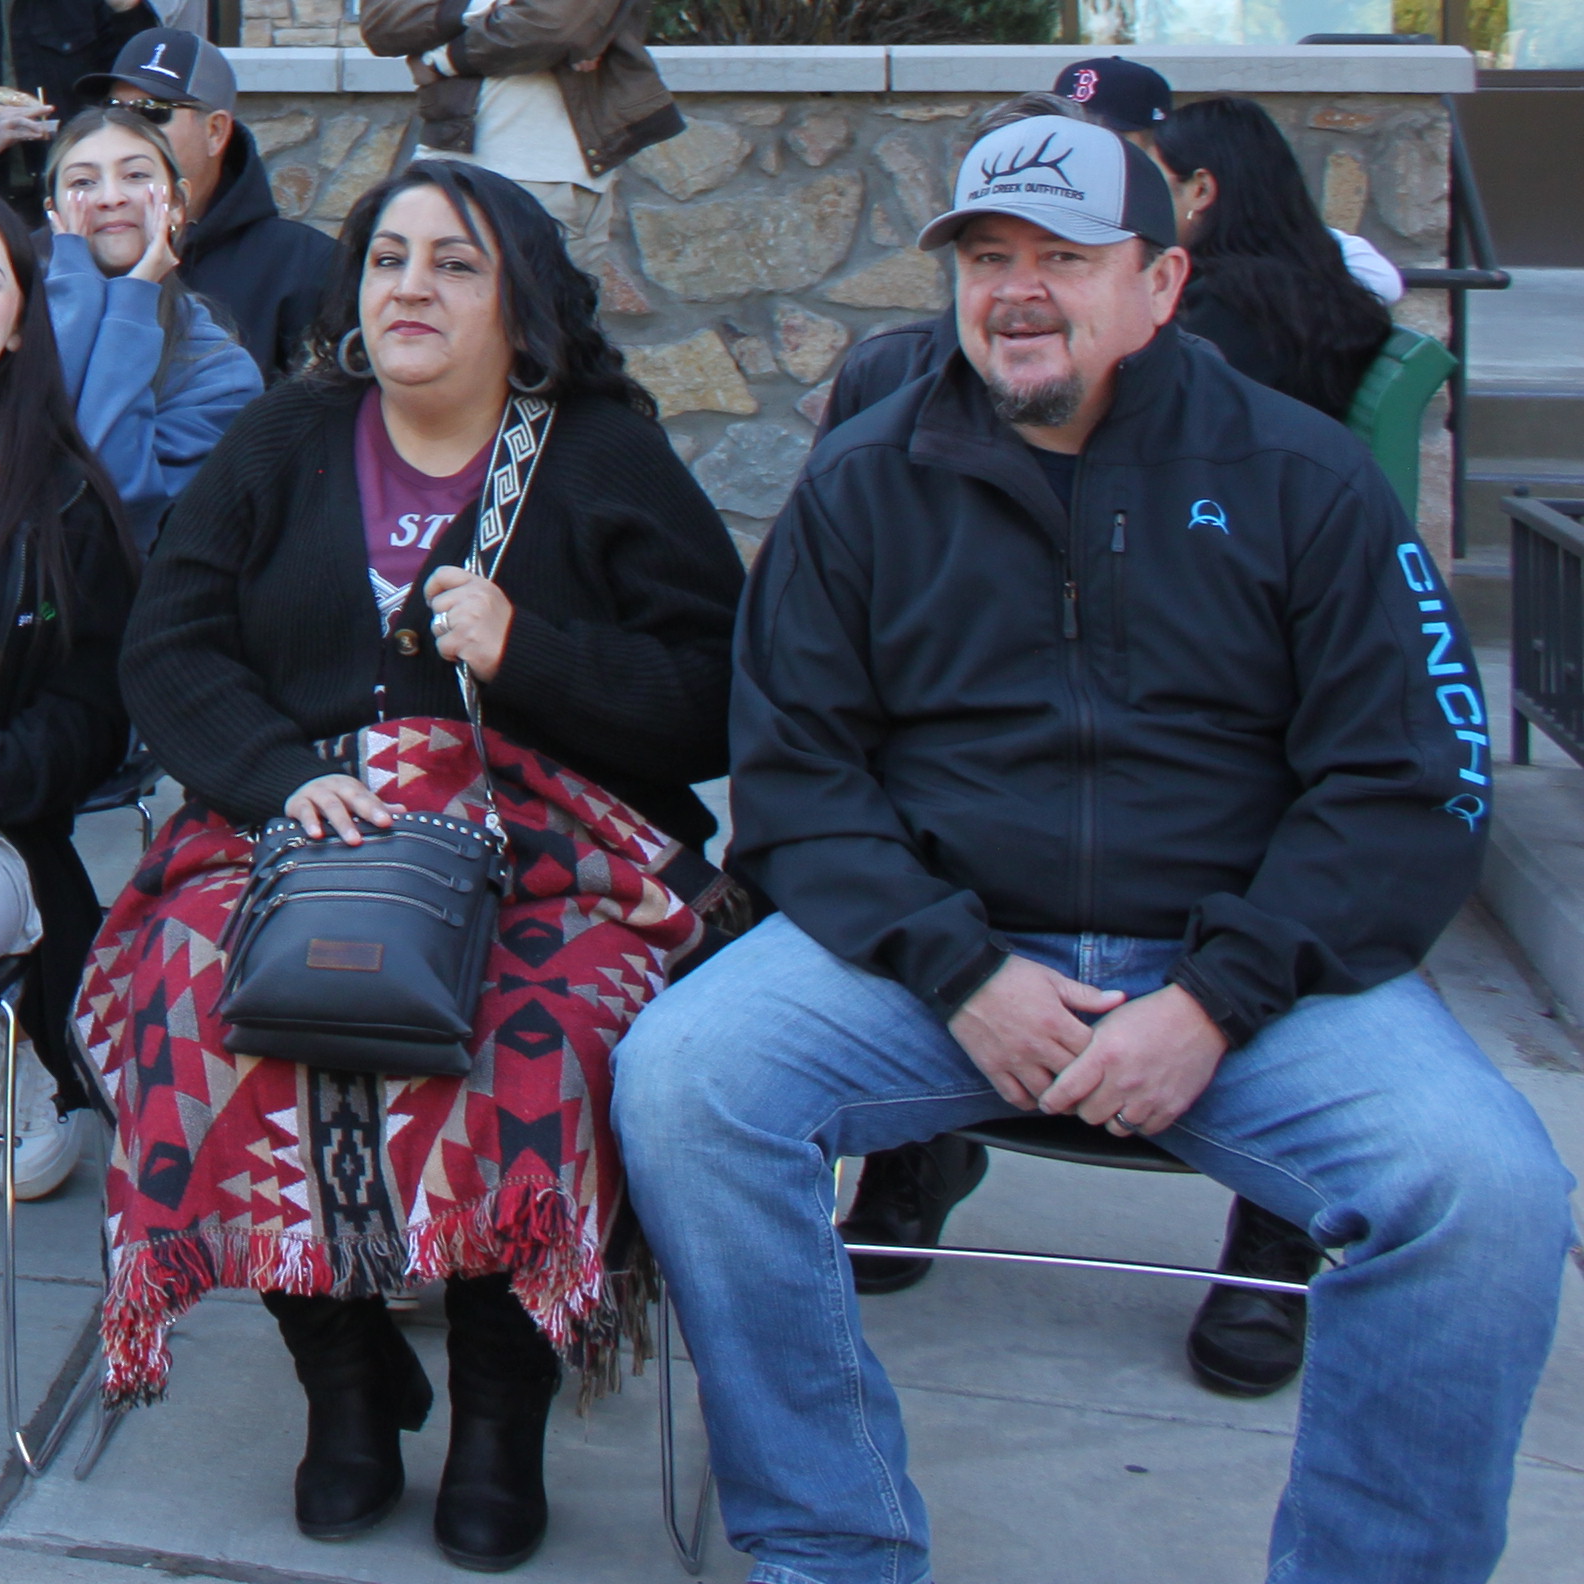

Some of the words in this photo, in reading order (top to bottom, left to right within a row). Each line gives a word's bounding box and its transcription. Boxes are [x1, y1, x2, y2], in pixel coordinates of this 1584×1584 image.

[1066, 68, 1099, 103] B
[1024, 182, 1086, 201] OUTFITTERS
[390, 513, 457, 550] ST
[1396, 542, 1491, 786] CINCH
